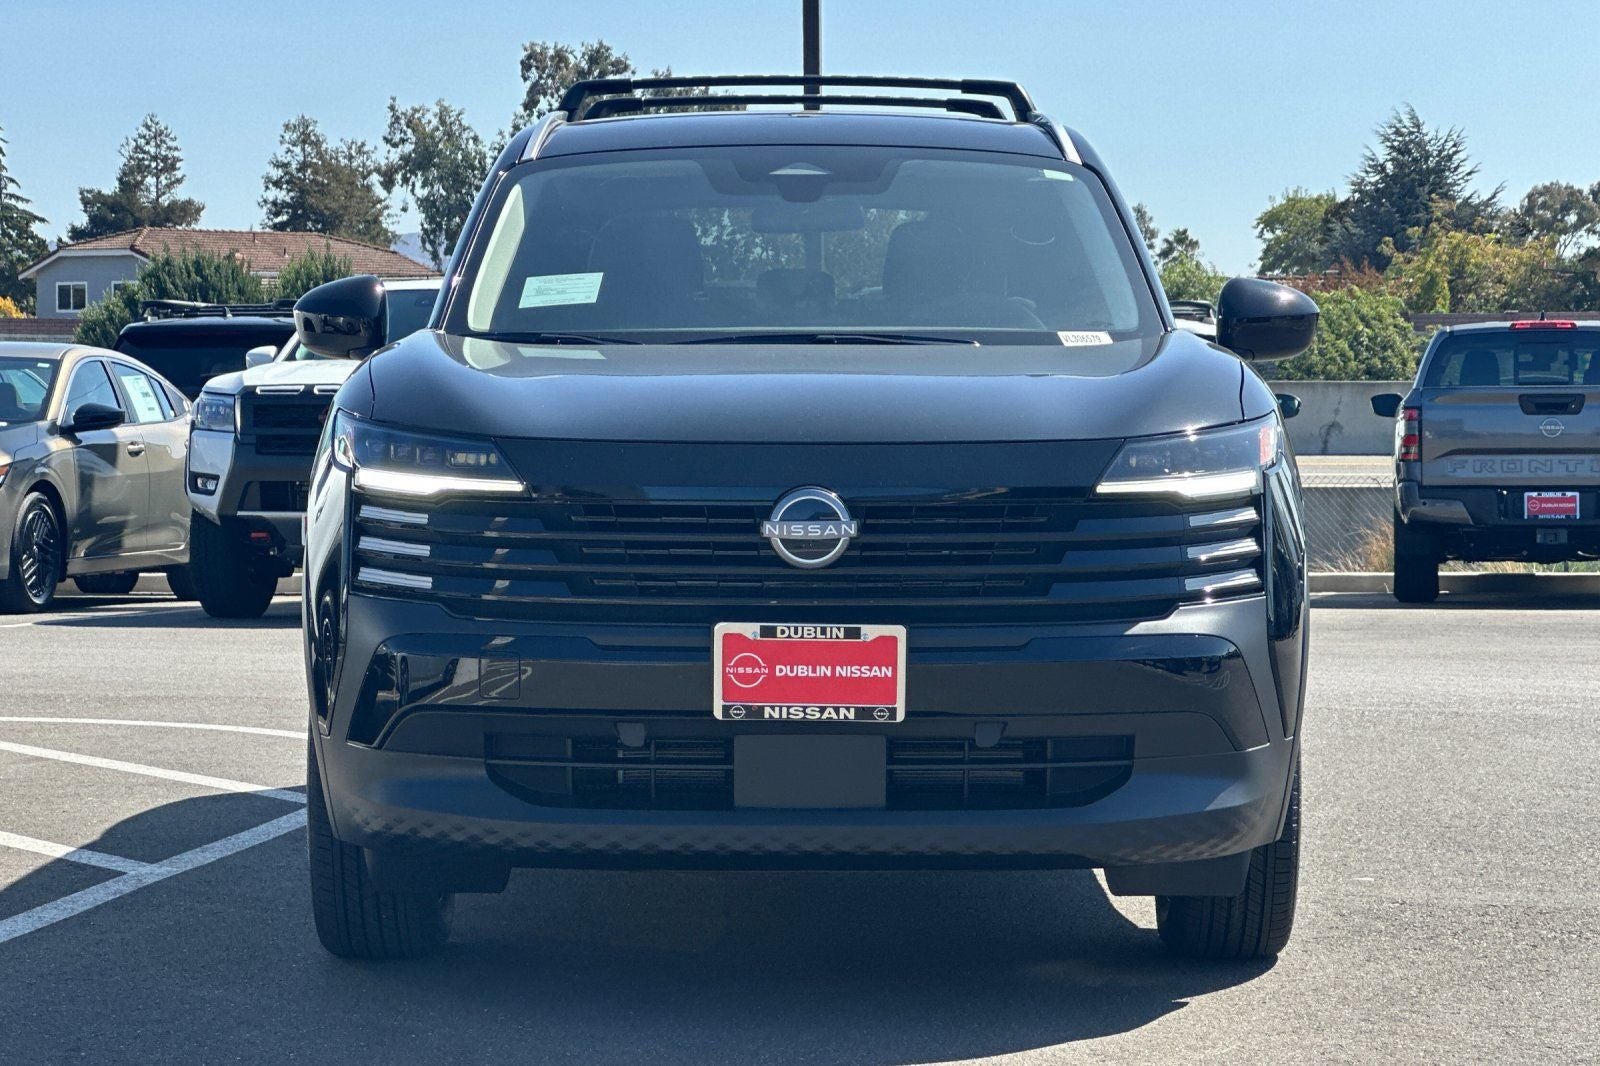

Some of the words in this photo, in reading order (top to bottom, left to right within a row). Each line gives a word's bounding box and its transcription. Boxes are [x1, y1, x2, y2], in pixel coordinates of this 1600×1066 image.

[765, 523, 856, 536] NISSAN
[776, 626, 845, 639] DUBLIN
[726, 666, 769, 674] NISSAN
[775, 665, 832, 677] DUBLIN
[835, 666, 892, 678] NISSAN
[764, 706, 855, 720] NISSAN
